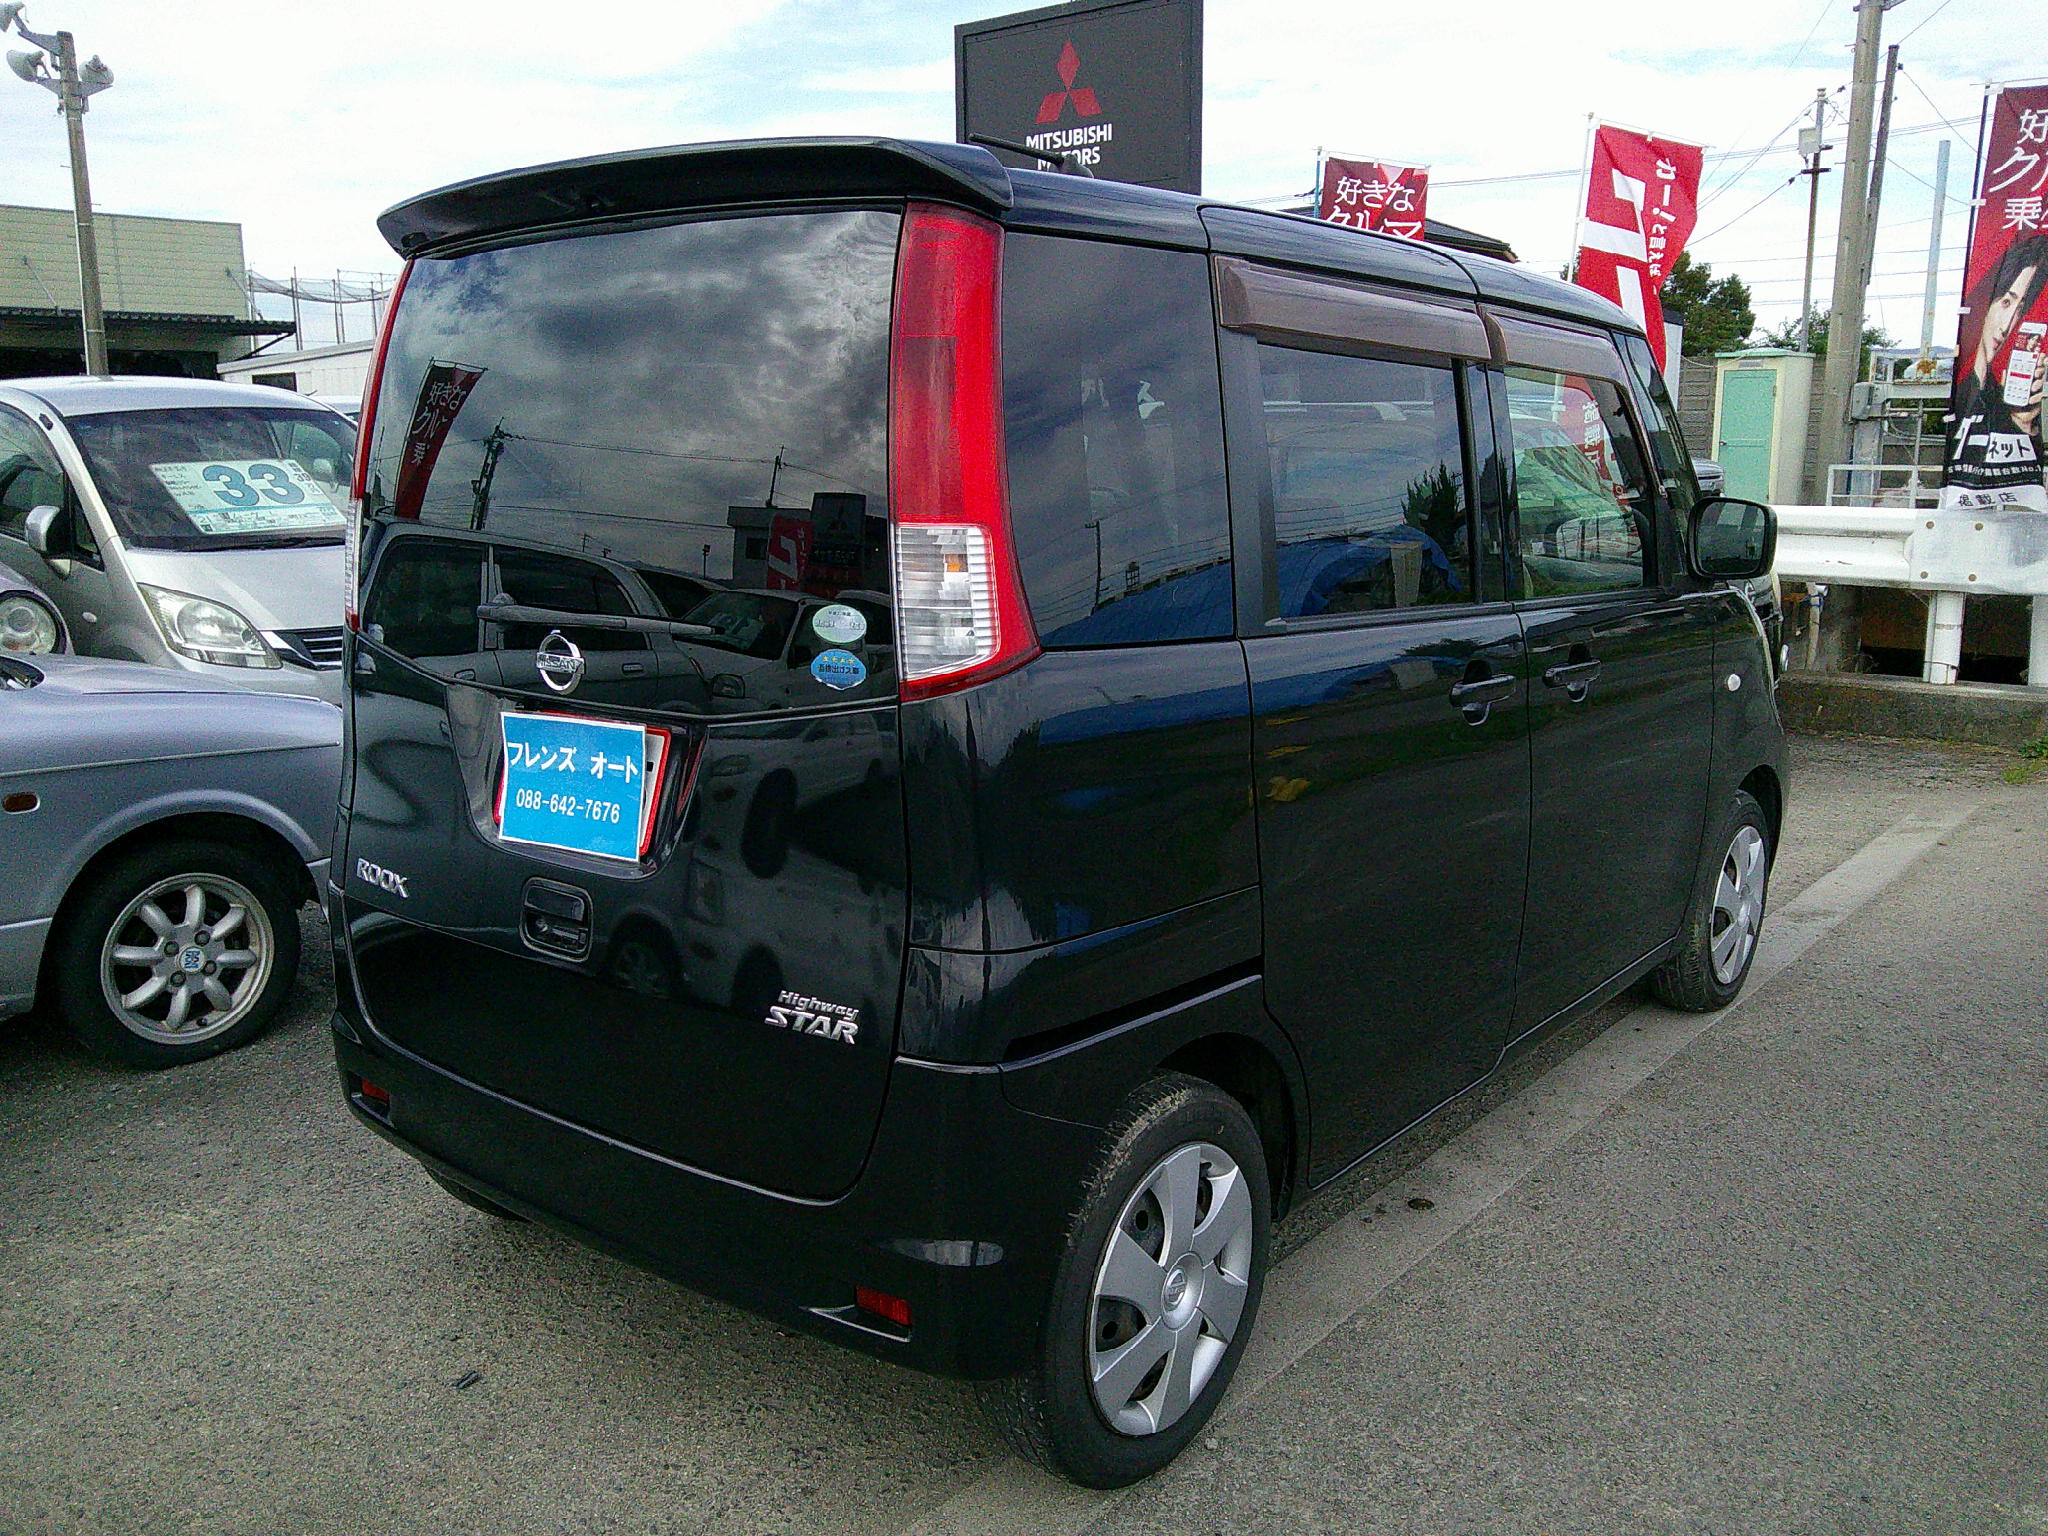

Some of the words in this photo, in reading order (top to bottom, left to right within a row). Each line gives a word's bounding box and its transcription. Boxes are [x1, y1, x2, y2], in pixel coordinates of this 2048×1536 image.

[1025, 123, 1112, 150] MITSUBISHI
[1988, 147, 2048, 192] ク
[1334, 176, 1416, 212] 好きな
[203, 464, 305, 507] 33
[538, 654, 577, 672] NISSAN
[507, 741, 577, 772] フレンズ
[590, 751, 638, 783] オート
[516, 788, 620, 824] 088-642-7676
[357, 857, 409, 898] ROOX
[778, 989, 859, 1021] Highway
[764, 1005, 858, 1045] STAR
